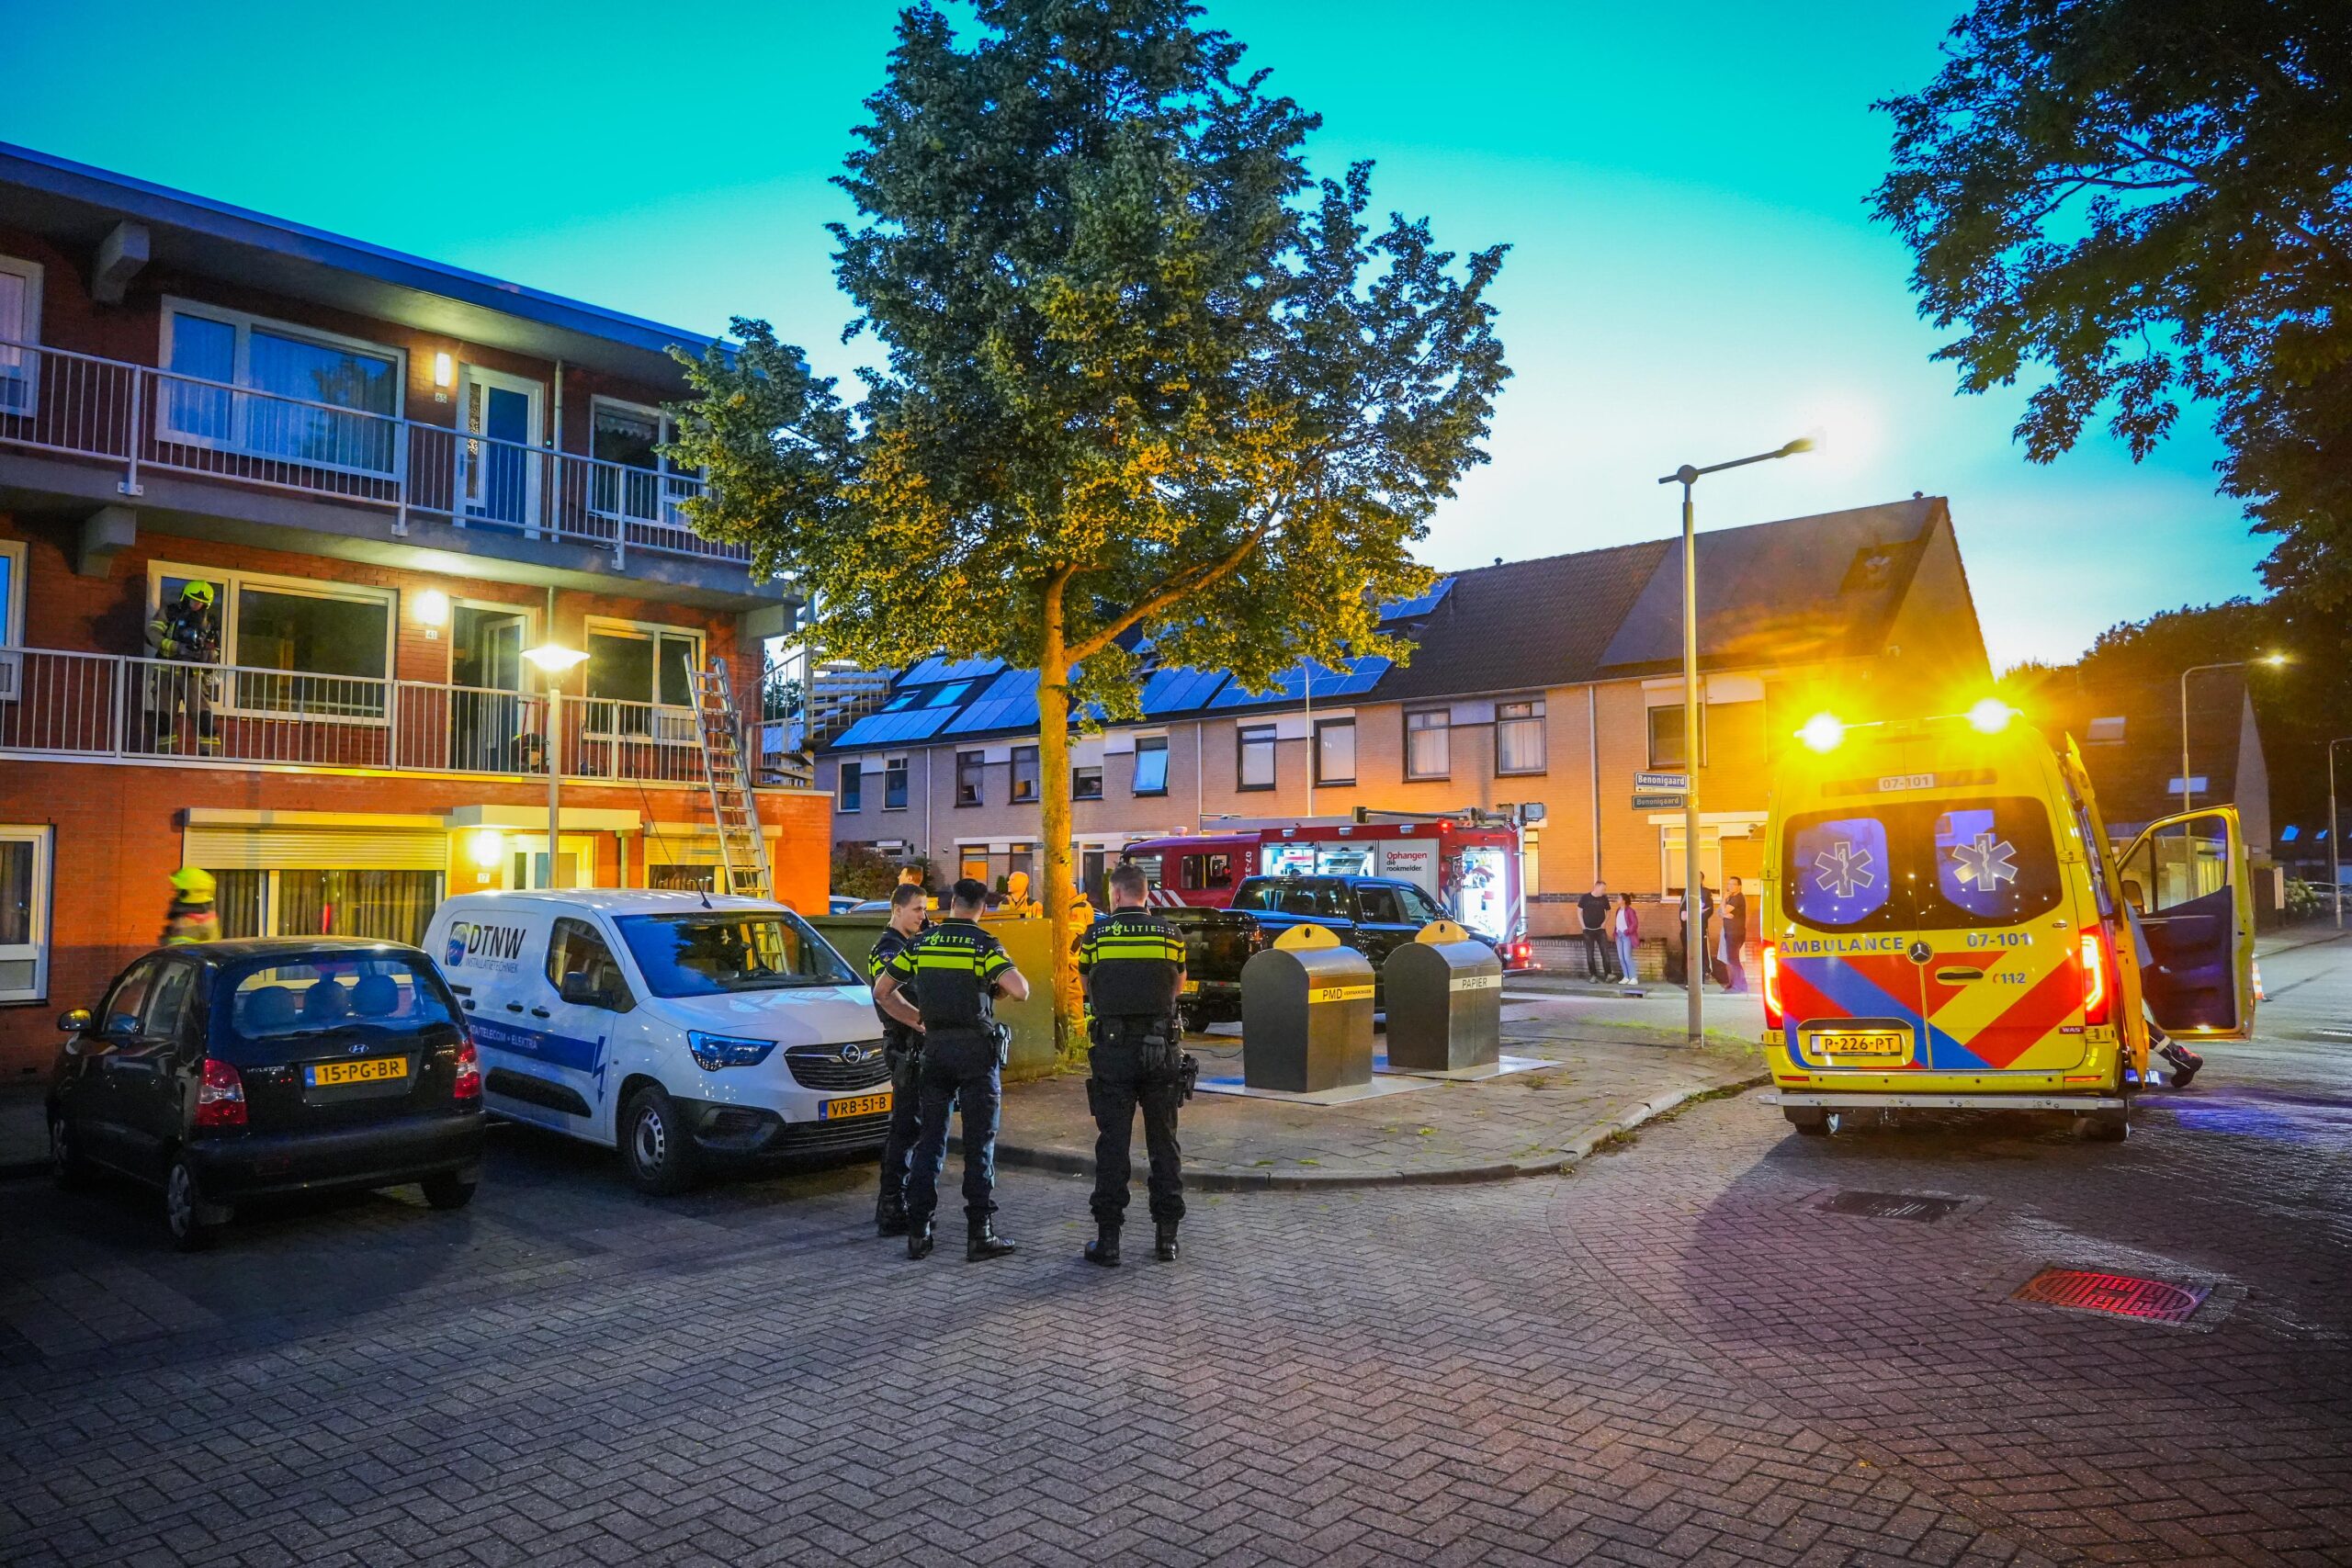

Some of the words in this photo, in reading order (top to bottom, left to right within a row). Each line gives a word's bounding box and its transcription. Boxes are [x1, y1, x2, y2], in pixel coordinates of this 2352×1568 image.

[1637, 774, 1685, 786] Benonigaard
[1882, 775, 1929, 789] 07-101
[1636, 796, 1679, 807] Benonigaard
[1386, 852, 1428, 862] Ophangen
[1104, 920, 1158, 936] POLITIE
[468, 924, 526, 960] DTNW
[924, 931, 972, 945] POLITIE
[1779, 936, 1905, 953] AMBULANCE
[1967, 932, 2031, 947] 07-101
[1462, 977, 1487, 989] PAPIER
[1323, 988, 1342, 1000] PMD
[511, 1034, 537, 1050] ELEKTRA
[1825, 1038, 1894, 1050] P-226-PT
[322, 1061, 401, 1082] 15-PG-BR
[832, 1097, 887, 1116] VRB-51-B
